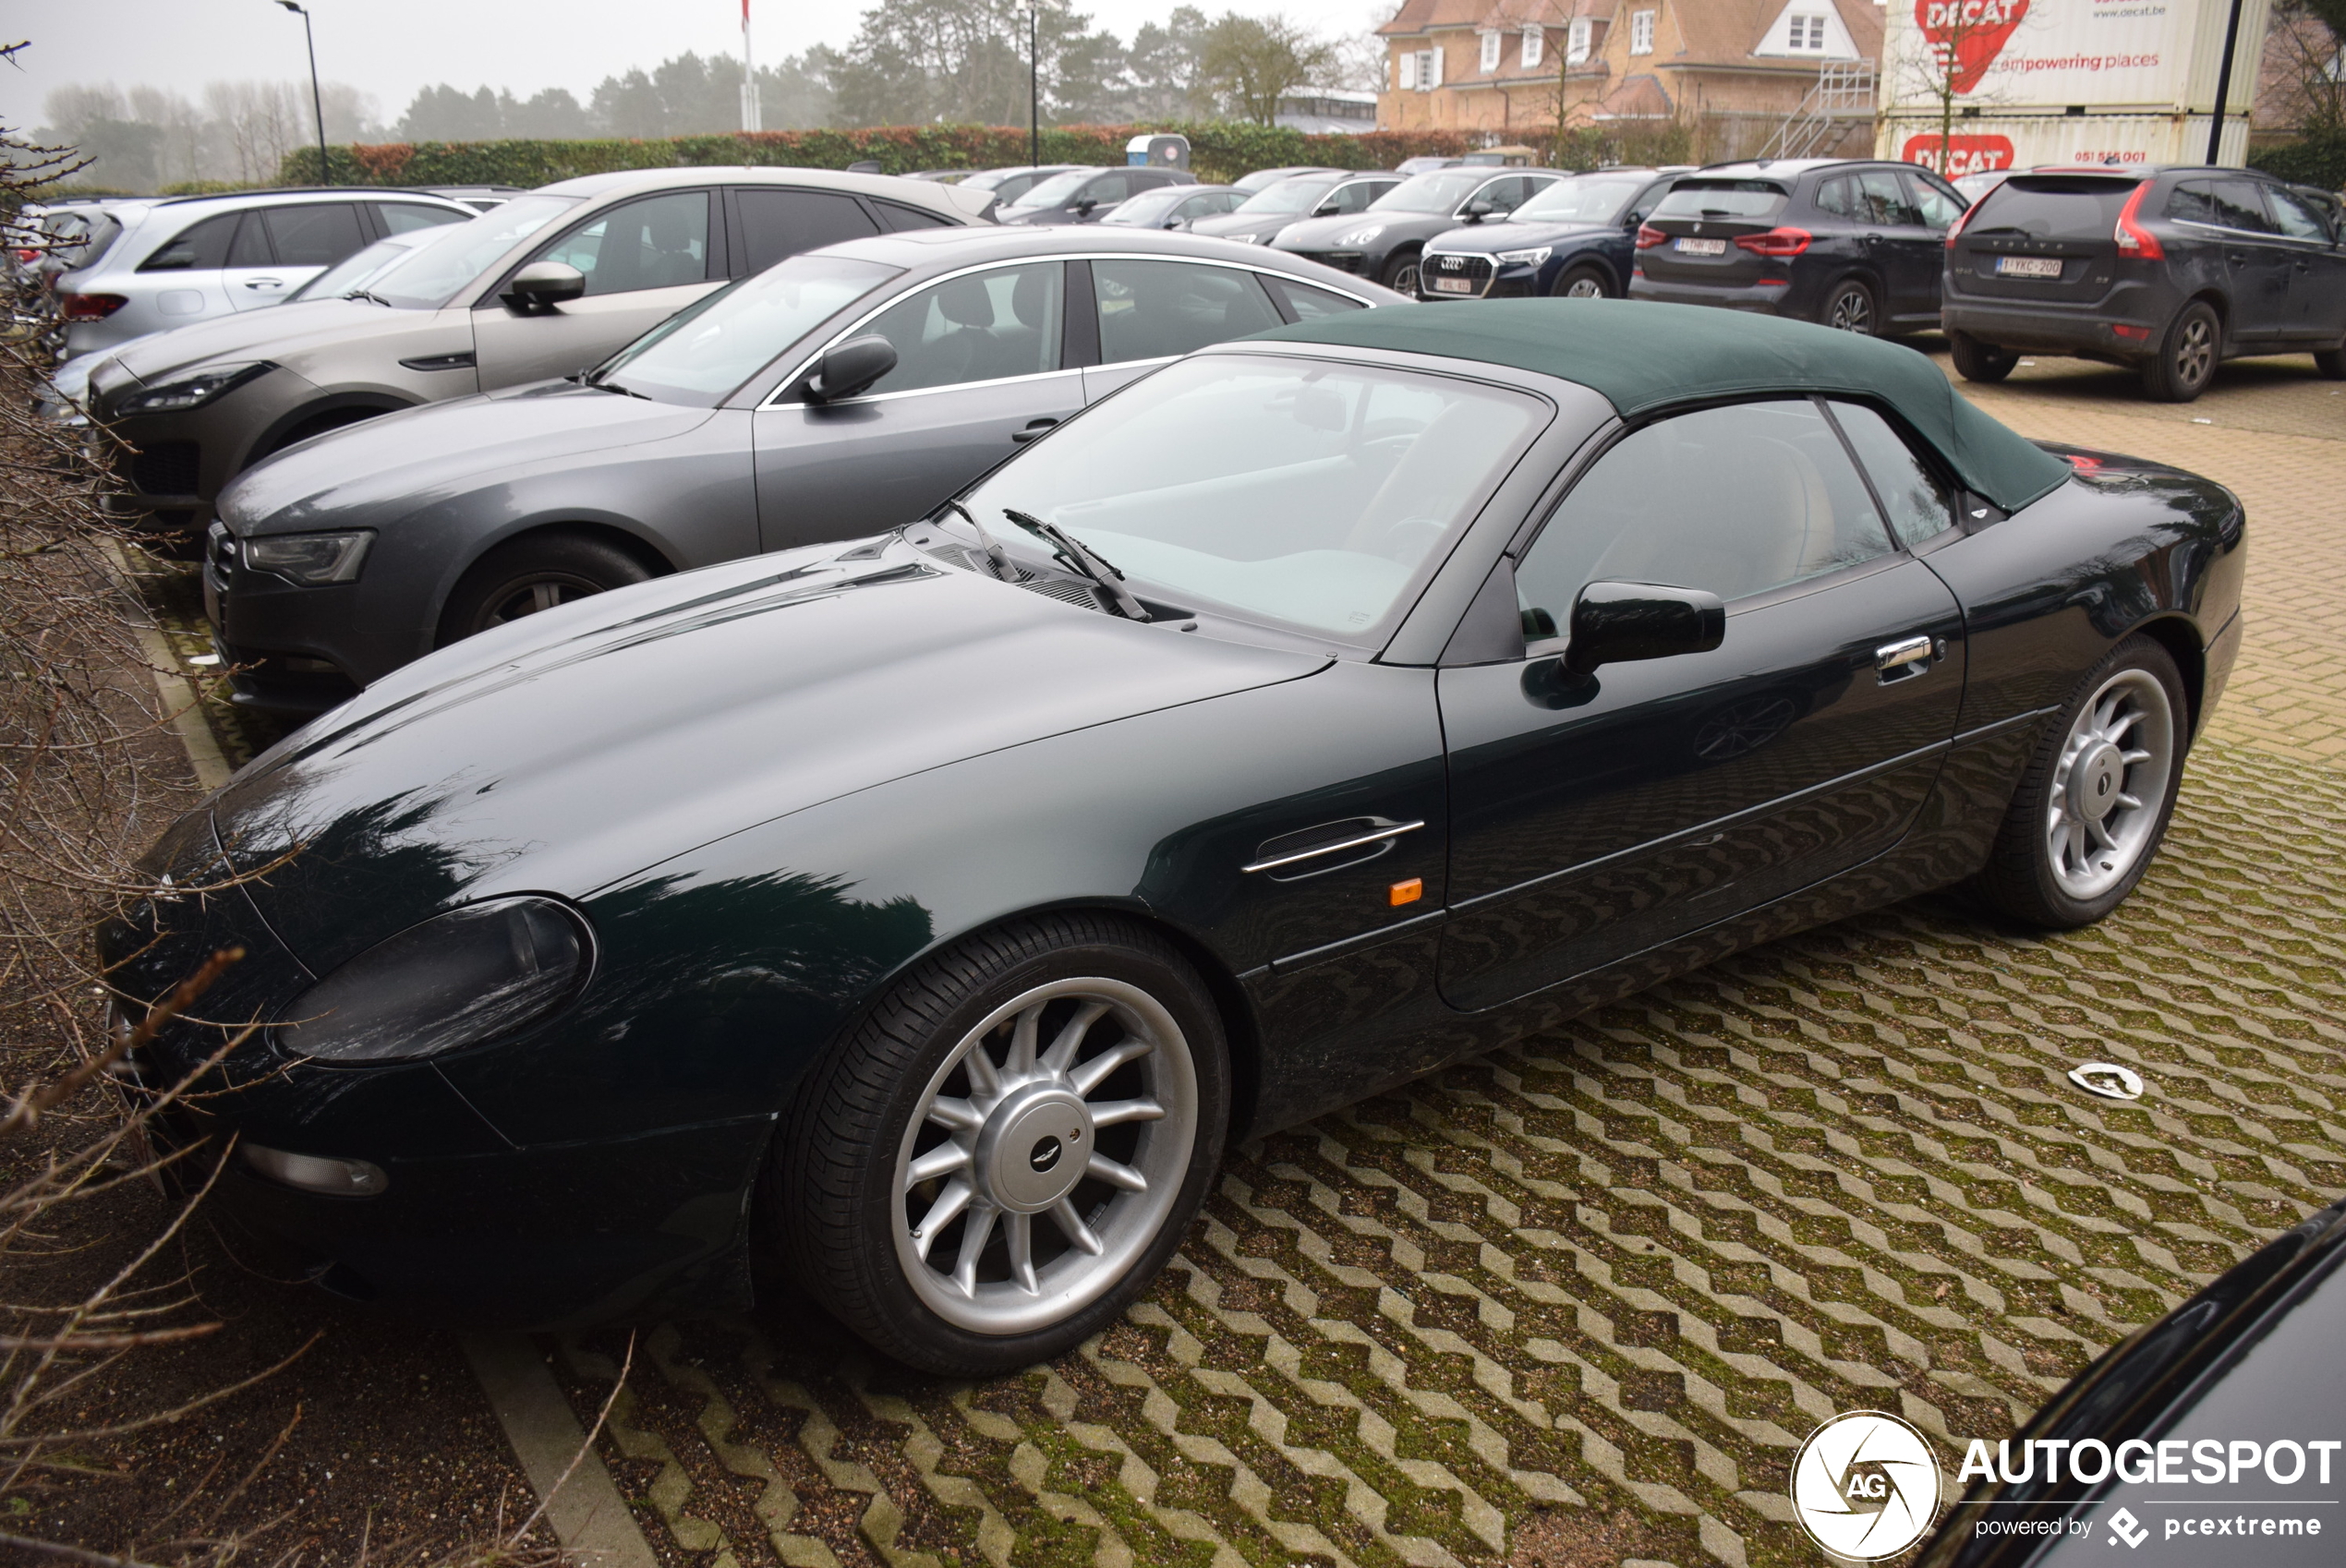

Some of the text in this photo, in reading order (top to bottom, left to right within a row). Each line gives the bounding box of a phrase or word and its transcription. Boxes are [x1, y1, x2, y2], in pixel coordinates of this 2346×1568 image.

[1926, 0, 2019, 29] DECAT
[2093, 6, 2166, 18] www.decat.be
[2001, 54, 2159, 72] empowering places
[2075, 151, 2095, 163] 051
[2122, 151, 2146, 163] 001
